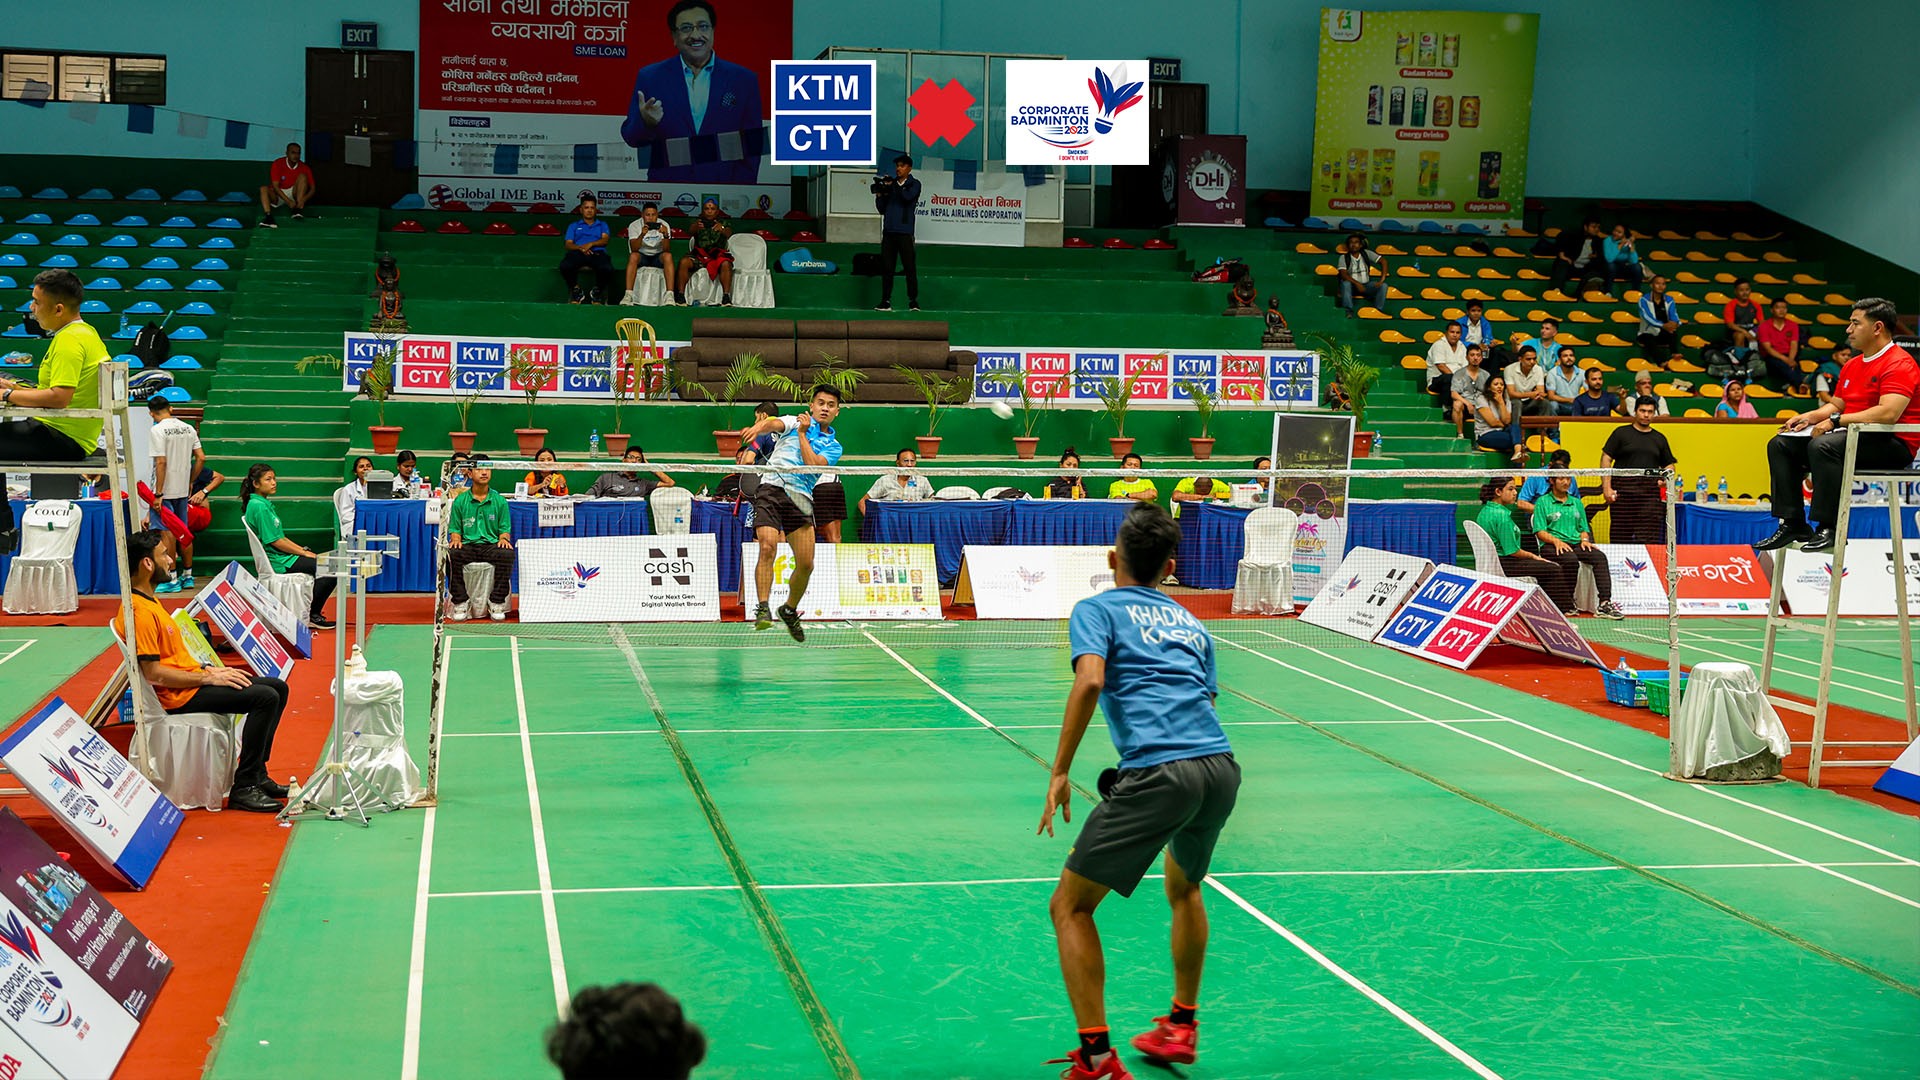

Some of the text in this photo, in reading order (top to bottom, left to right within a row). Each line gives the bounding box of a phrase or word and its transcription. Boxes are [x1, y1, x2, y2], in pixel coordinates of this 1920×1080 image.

[346, 28, 373, 42] EXIT
[490, 19, 628, 42] व्यवसायी कर्जा
[575, 46, 625, 57] SME LOAN
[1153, 63, 1177, 76] EXIT
[454, 188, 565, 201] Global IME Bank
[931, 193, 1021, 209] नेपाल वायुसेवा निगम
[931, 208, 1022, 220] NEPAL AIRLINES CORPORATION
[1469, 203, 1488, 211] Apple
[408, 345, 445, 360] KTM
[463, 347, 499, 361] KTM
[517, 349, 552, 363] KTM
[570, 350, 606, 363] KTM
[982, 357, 1015, 370] KTM
[1032, 357, 1064, 371] KTM
[1081, 358, 1114, 371] KTM
[1130, 358, 1163, 371] KTM
[1179, 359, 1211, 373] KTM
[1227, 360, 1260, 373] KTM
[408, 369, 444, 383] CTY
[463, 371, 498, 386] CTY
[570, 374, 603, 388] CTY
[982, 381, 1013, 394] CTY
[1131, 382, 1161, 395] CTY
[34, 508, 70, 516] COACH
[644, 558, 694, 574] cash
[1373, 581, 1398, 595] cash
[1422, 580, 1507, 617] KTM KTM
[213, 590, 248, 631] KTM KTM
[1394, 614, 1480, 653] CTY CTY
[249, 631, 281, 674] CTY CTY
[103, 754, 127, 781] SALICO
[60, 787, 80, 808] CORPORATE
[67, 795, 88, 819] BADMINTON
[66, 897, 100, 943] A wide range of
[77, 909, 124, 970] Smart Home Appliances
[6, 975, 45, 1022] BADMINTON
